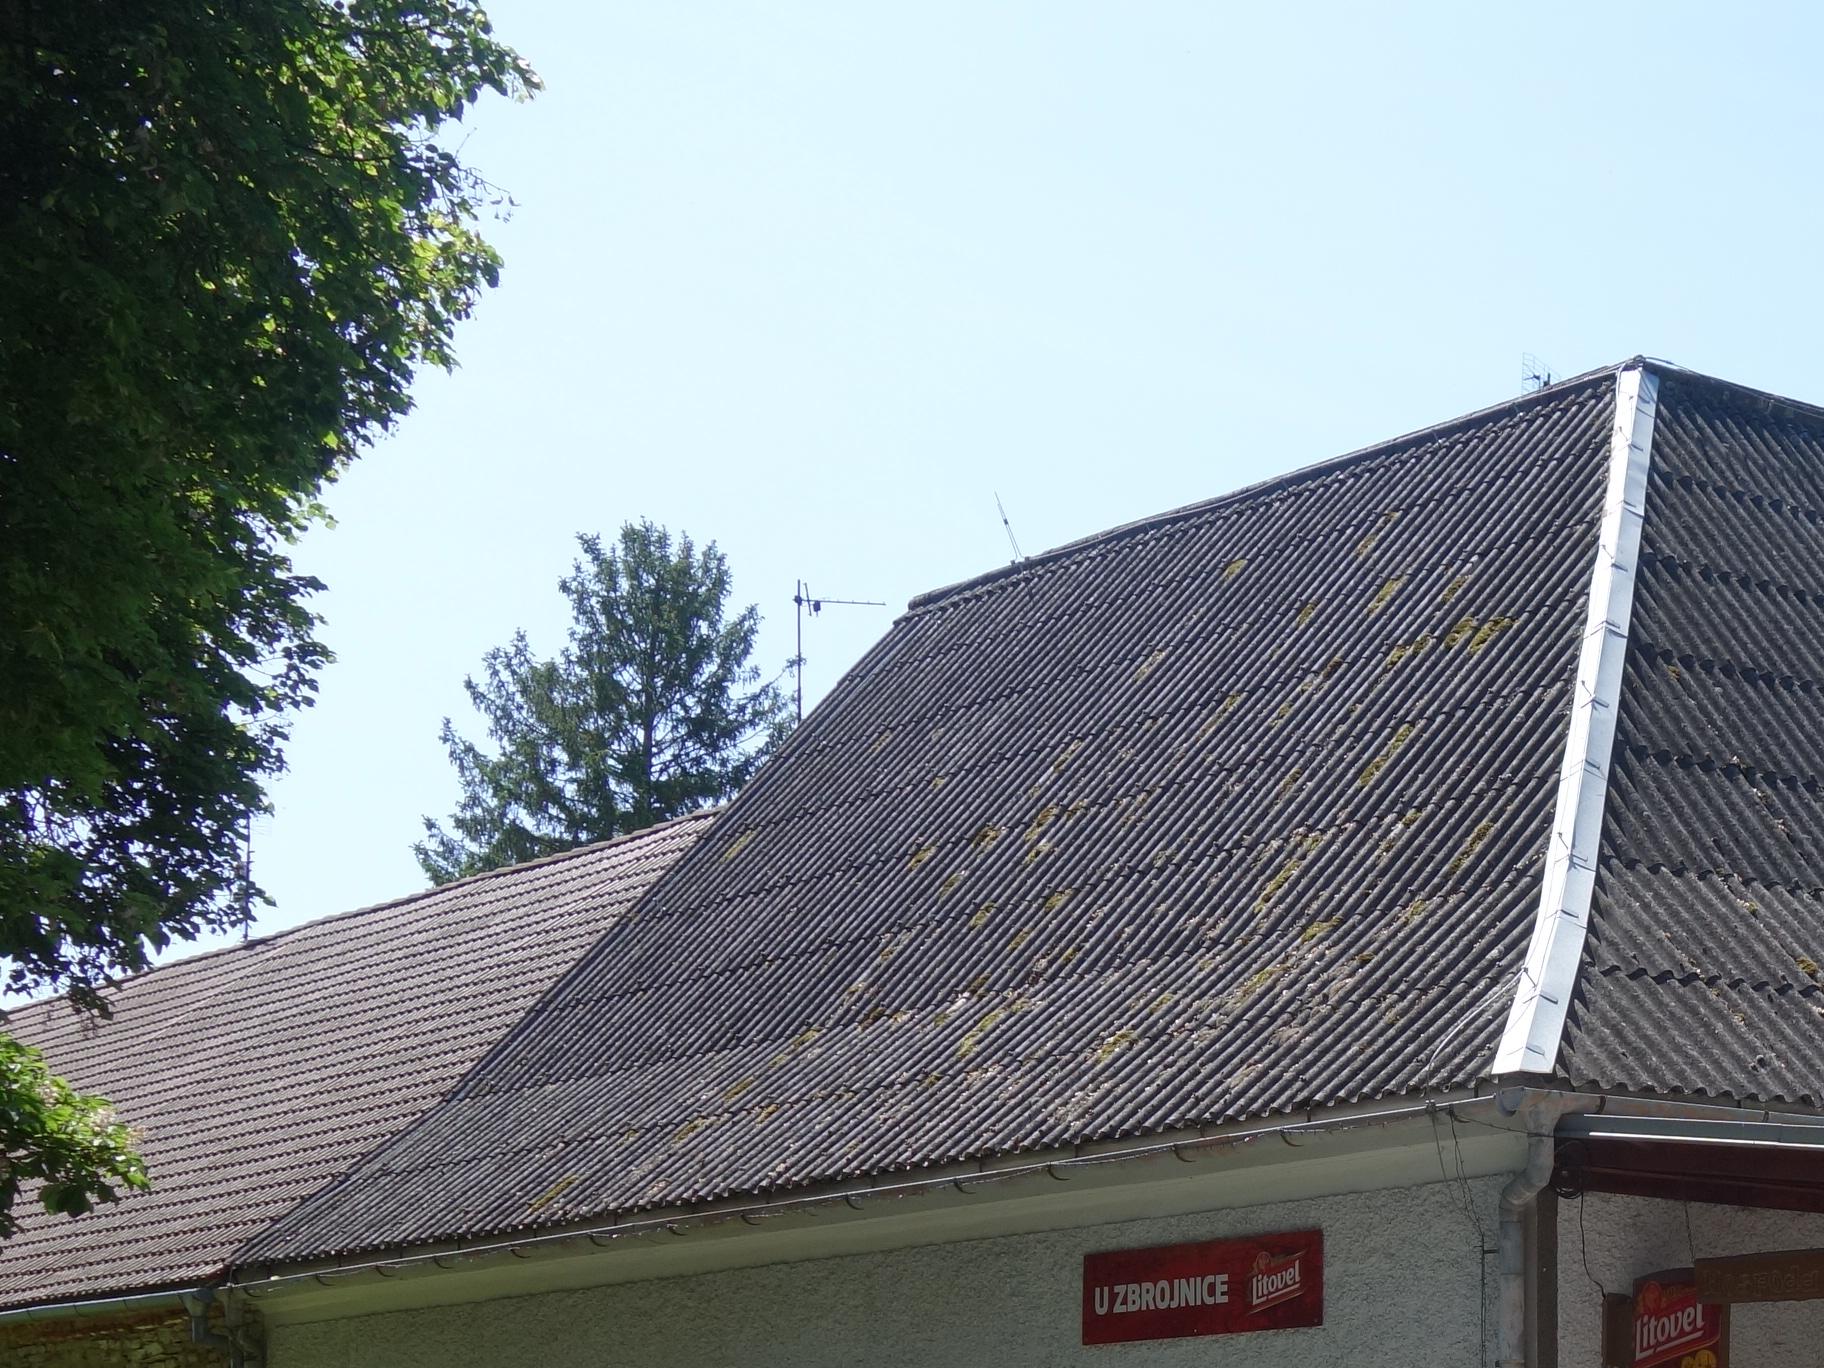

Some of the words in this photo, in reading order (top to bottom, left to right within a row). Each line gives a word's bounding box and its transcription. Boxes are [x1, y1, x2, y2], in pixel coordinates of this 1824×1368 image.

[1095, 1287, 1108, 1315] U
[1113, 1274, 1229, 1313] ZBROJNICE
[1252, 1260, 1301, 1304] Litovel
[1635, 1303, 1704, 1360] Litovel
